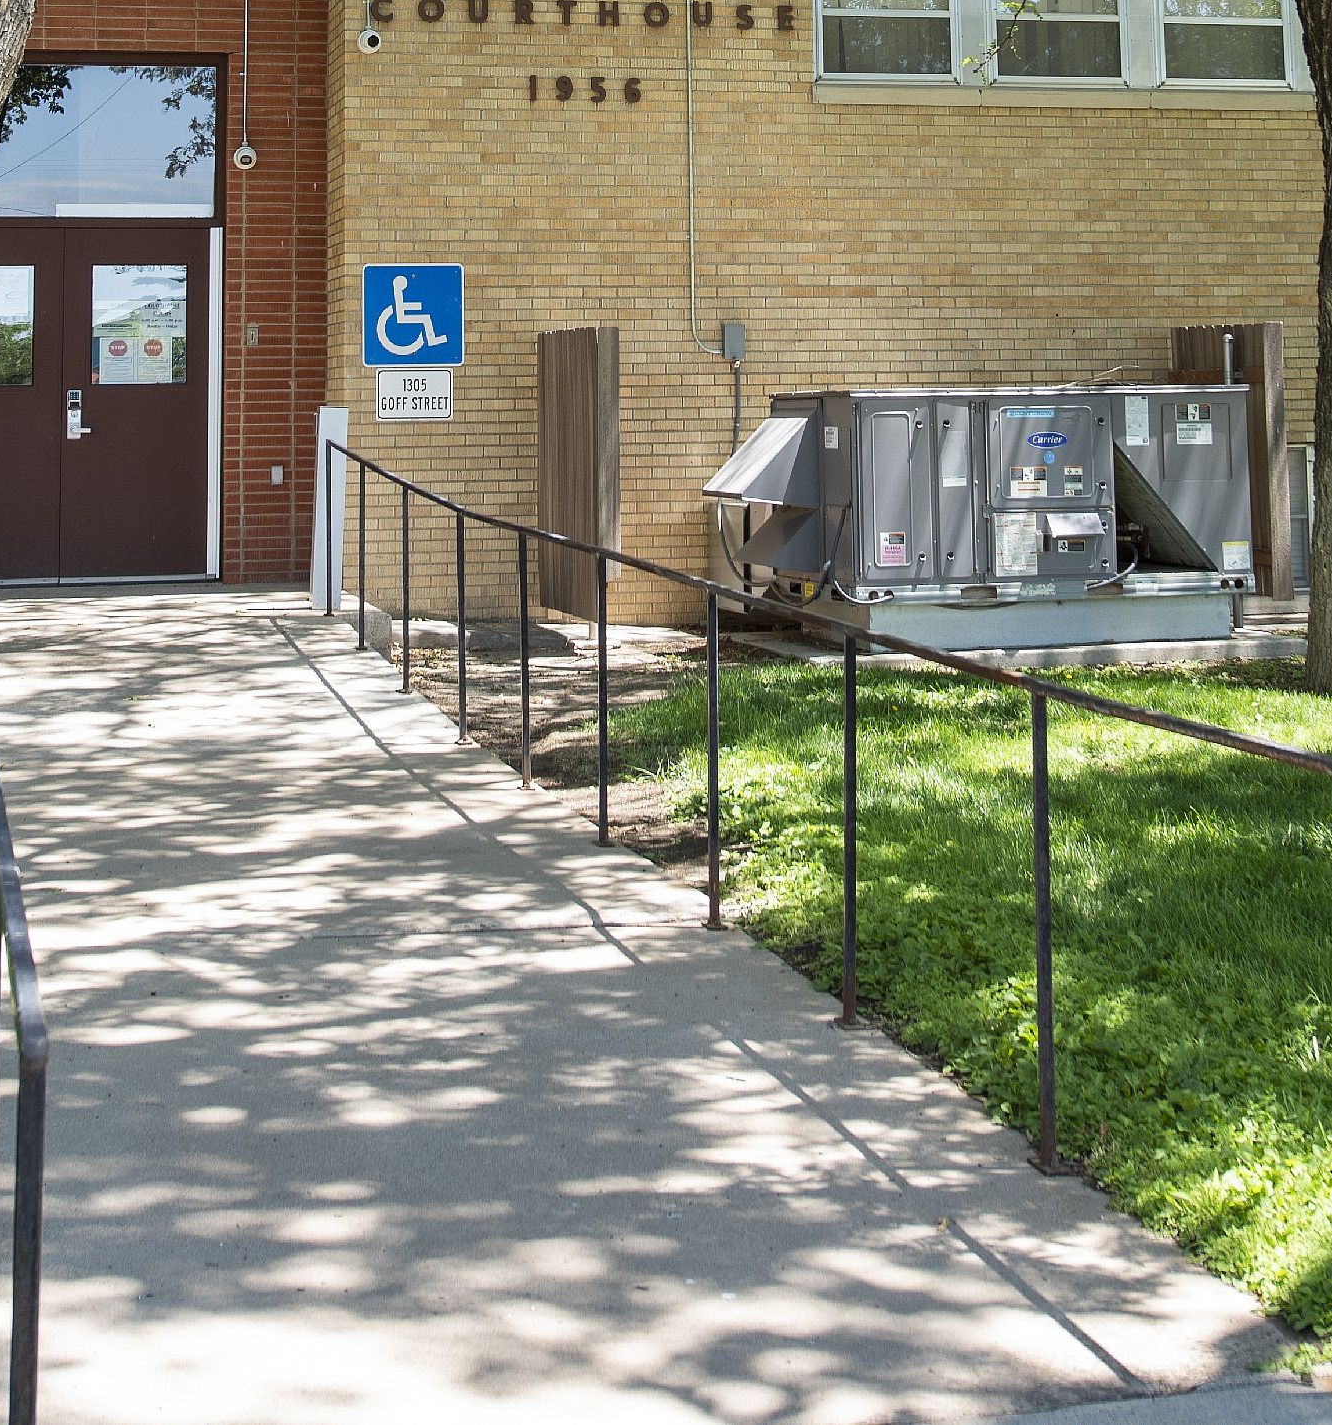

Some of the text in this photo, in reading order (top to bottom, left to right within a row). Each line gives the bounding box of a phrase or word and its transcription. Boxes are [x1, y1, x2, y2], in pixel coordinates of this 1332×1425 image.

[528, 74, 643, 104] 1956
[402, 378, 428, 392] 1305
[381, 396, 449, 411] GOFF STREET
[1032, 434, 1063, 444] Carrier
